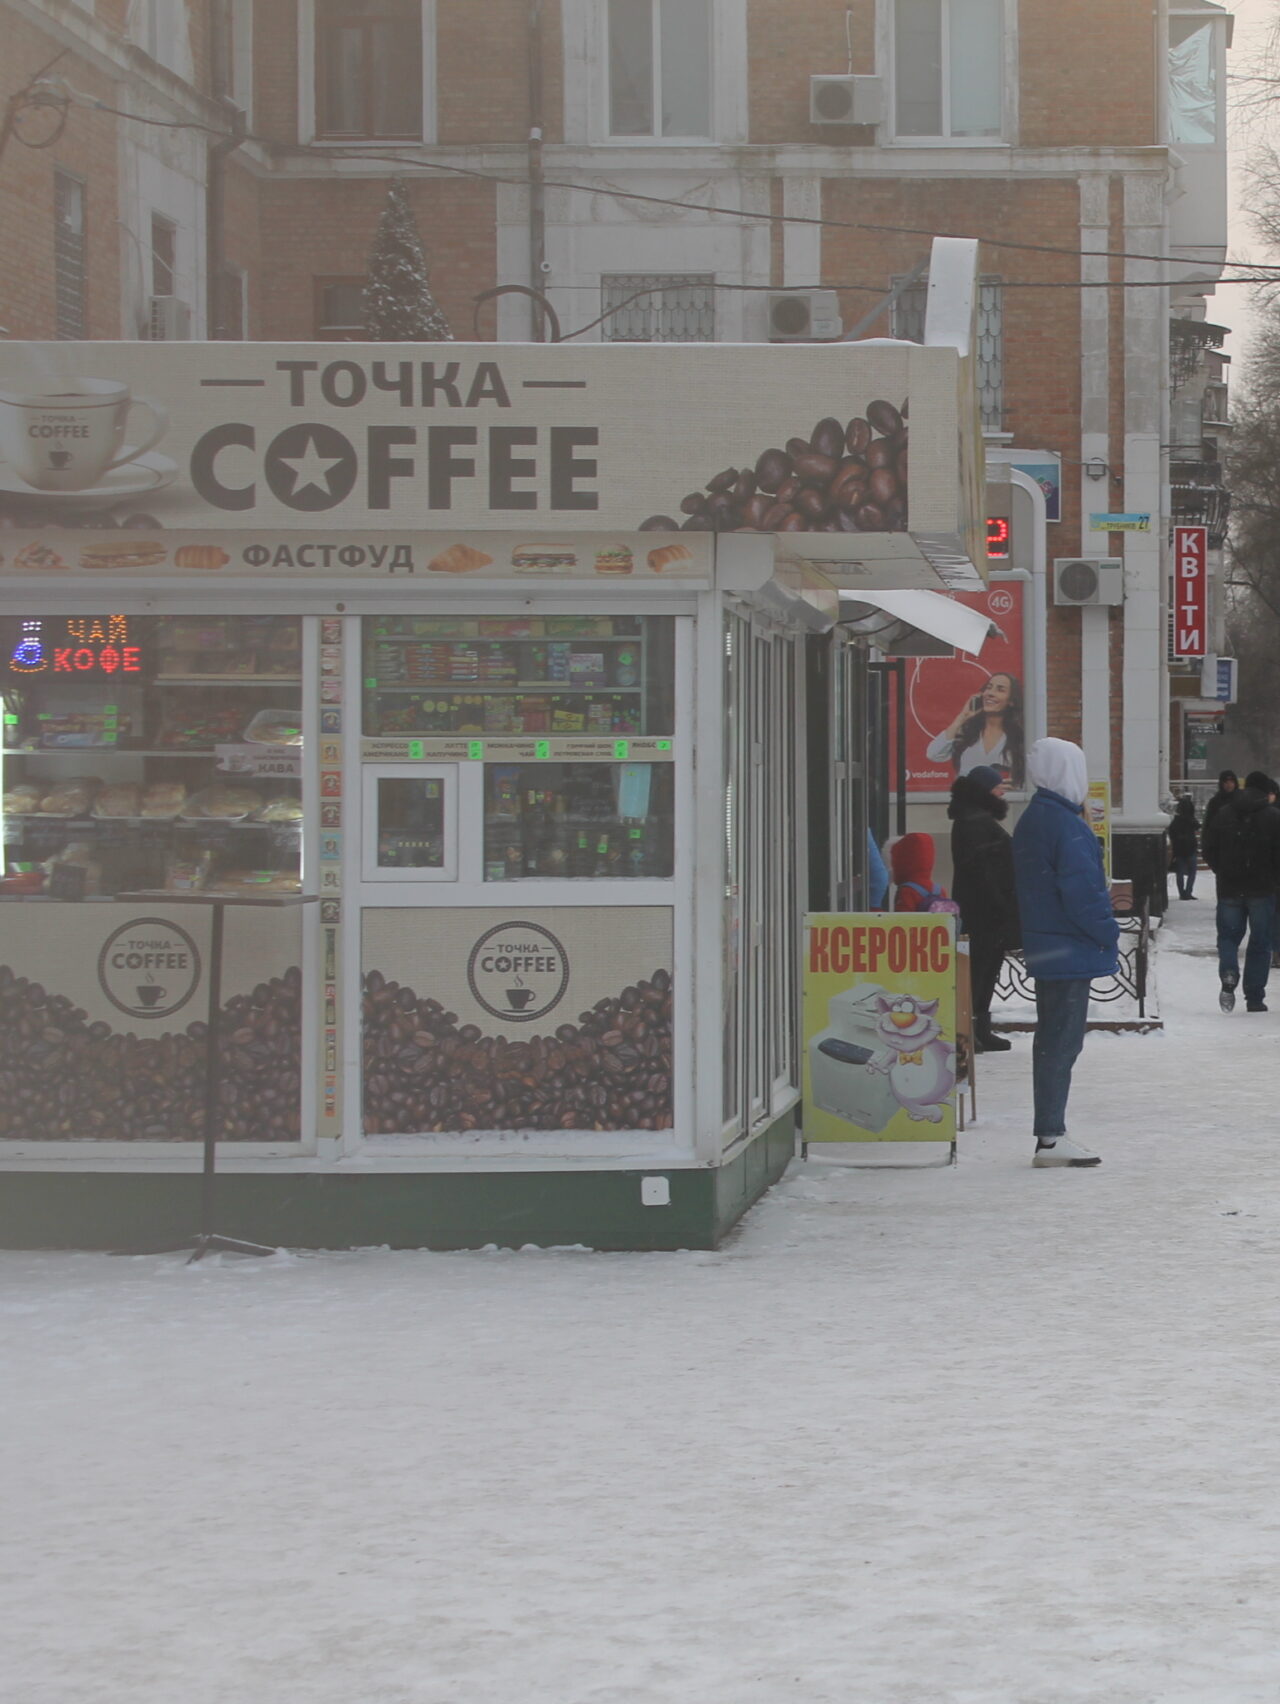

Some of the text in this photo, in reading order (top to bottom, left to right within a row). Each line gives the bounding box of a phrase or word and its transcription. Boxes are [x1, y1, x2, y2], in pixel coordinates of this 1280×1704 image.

[276, 360, 511, 407] ТОЧКА
[28, 424, 90, 438] COFFEE
[190, 422, 599, 511] COFFEE
[1138, 516, 1150, 529] 27
[242, 543, 414, 573] ФАСТФУД
[1180, 532, 1200, 650] КВІТИ
[991, 596, 1010, 610] 4G
[67, 615, 127, 643] ЧАЙ
[53, 646, 141, 673] КОФЕ
[258, 763, 294, 773] КАВА
[912, 770, 949, 778] vodafone
[128, 940, 171, 950] ТОЧКА
[497, 944, 539, 953] ТОЧКА
[809, 926, 949, 973] КСЕРОКС
[112, 953, 187, 969] COFFEE
[481, 956, 556, 973] COFFEE
